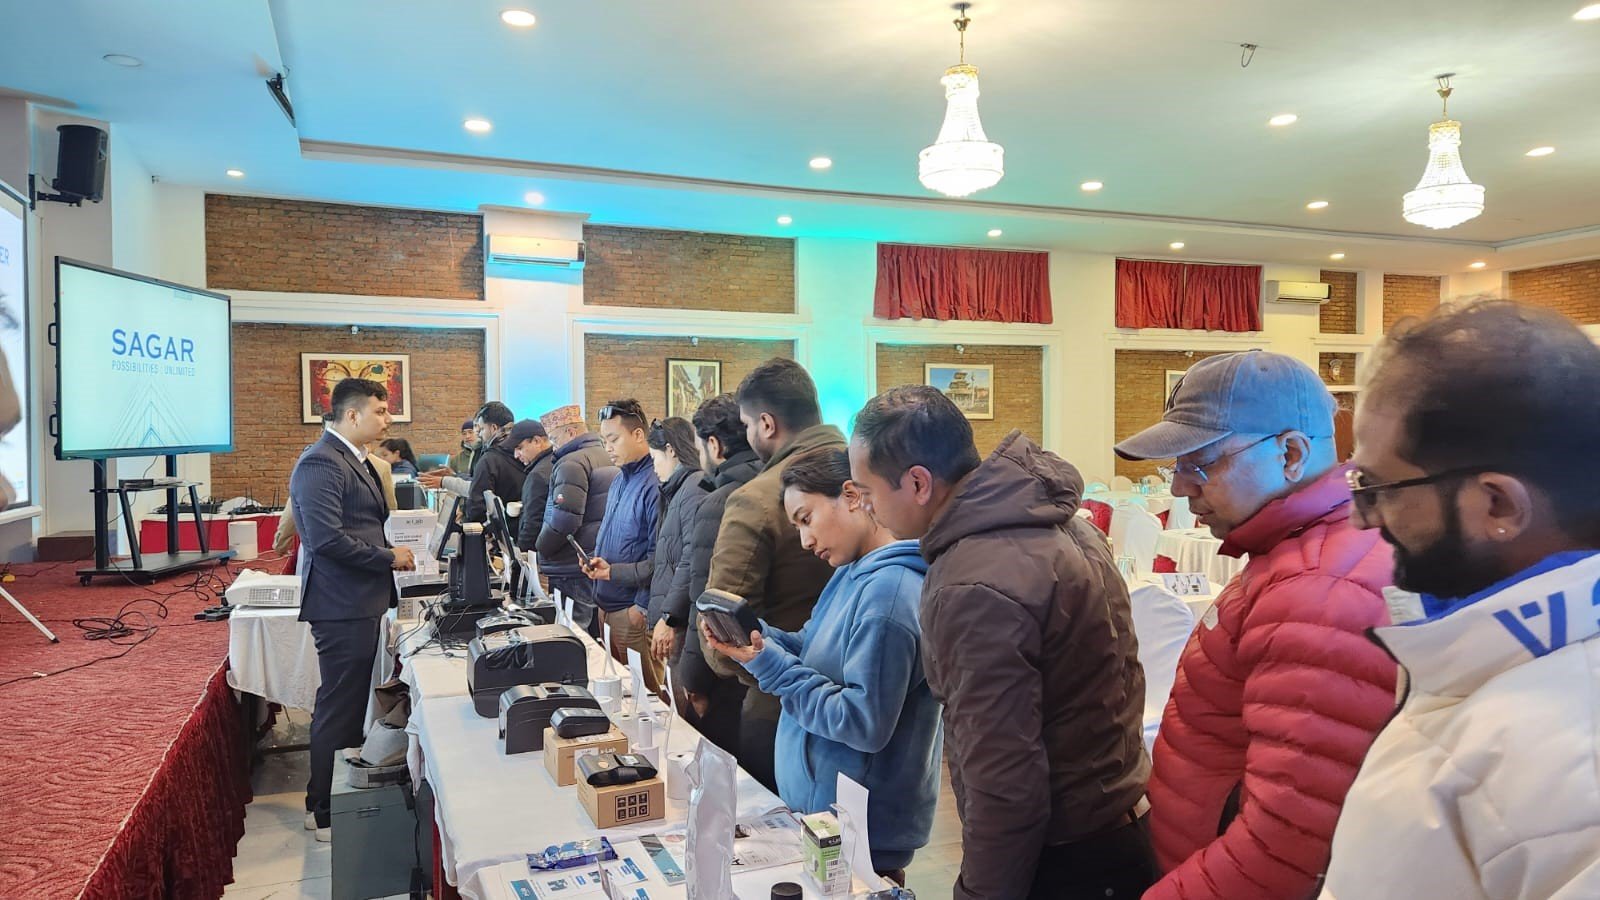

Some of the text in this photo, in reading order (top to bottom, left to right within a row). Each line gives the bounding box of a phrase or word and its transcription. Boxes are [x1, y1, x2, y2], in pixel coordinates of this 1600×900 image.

[112, 328, 194, 362] SAGAR
[112, 360, 159, 374] POSSIBILITIES
[164, 365, 195, 377] UNLIMITED
